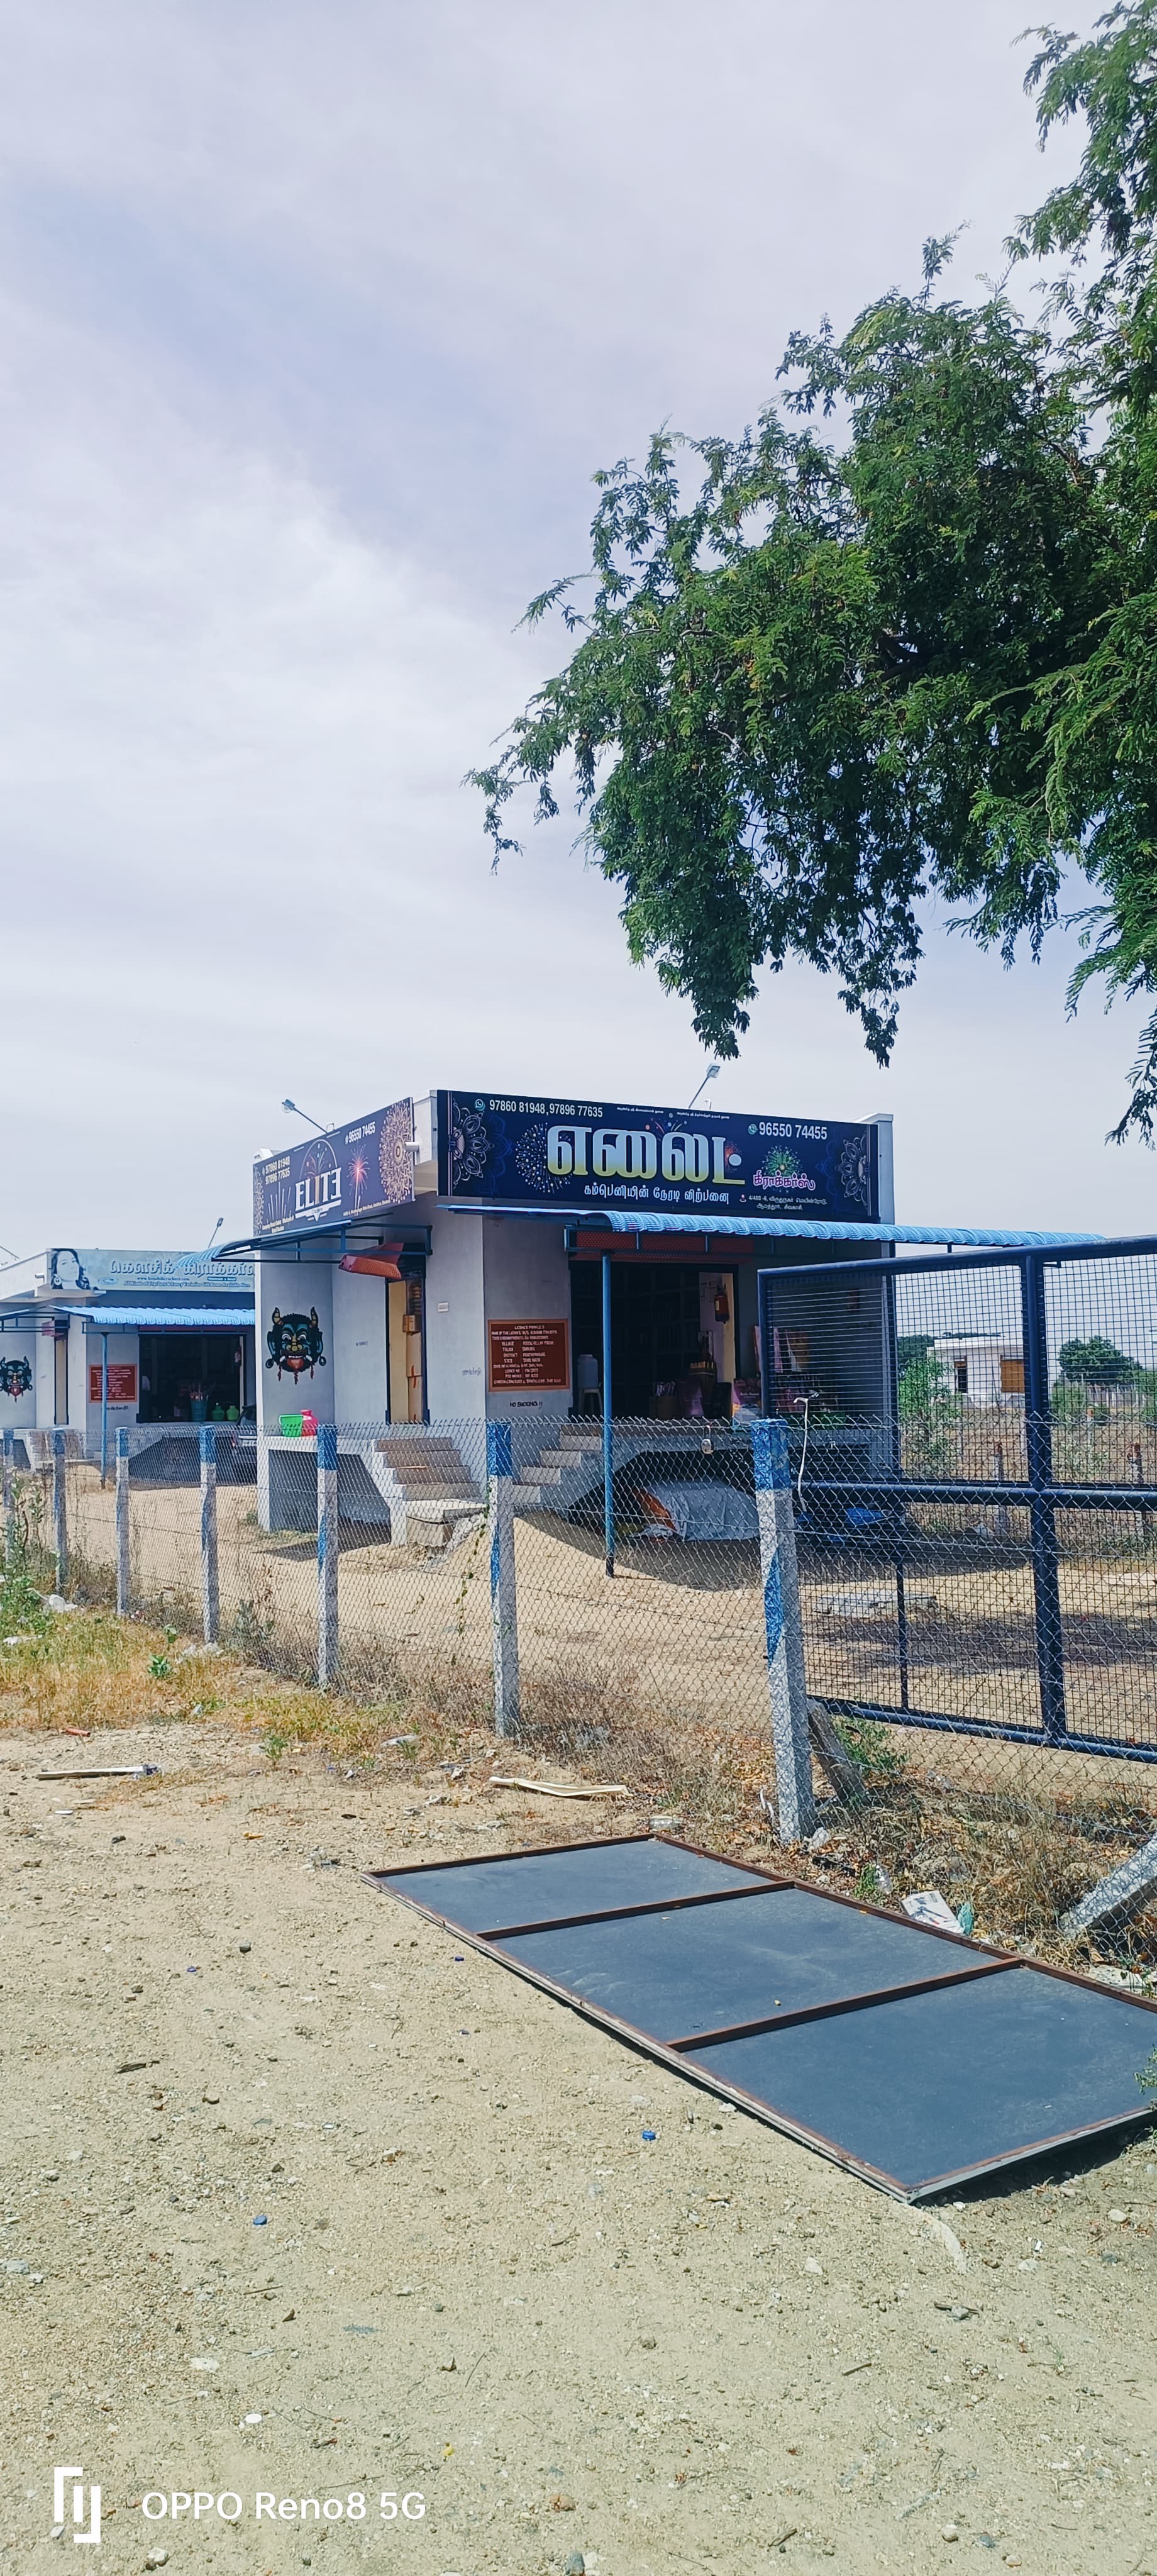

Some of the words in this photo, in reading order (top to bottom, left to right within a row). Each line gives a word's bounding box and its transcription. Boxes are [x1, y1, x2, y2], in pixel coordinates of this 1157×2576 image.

[489, 1099, 516, 1111] 97860
[577, 1106, 603, 1118] 77635
[348, 1126, 362, 1143] 96550
[362, 1121, 376, 1139] 74455
[759, 1122, 792, 1138] 96550
[795, 1125, 828, 1140] 74455
[547, 1125, 745, 1185] எலைட்
[295, 1167, 342, 1211] ELITE
[753, 1170, 816, 1191] கிராக்கர்ஸ்
[584, 1182, 649, 1200] கம்பெனியின்
[653, 1187, 680, 1202] நேரடி
[684, 1188, 729, 1204] விற்பனை
